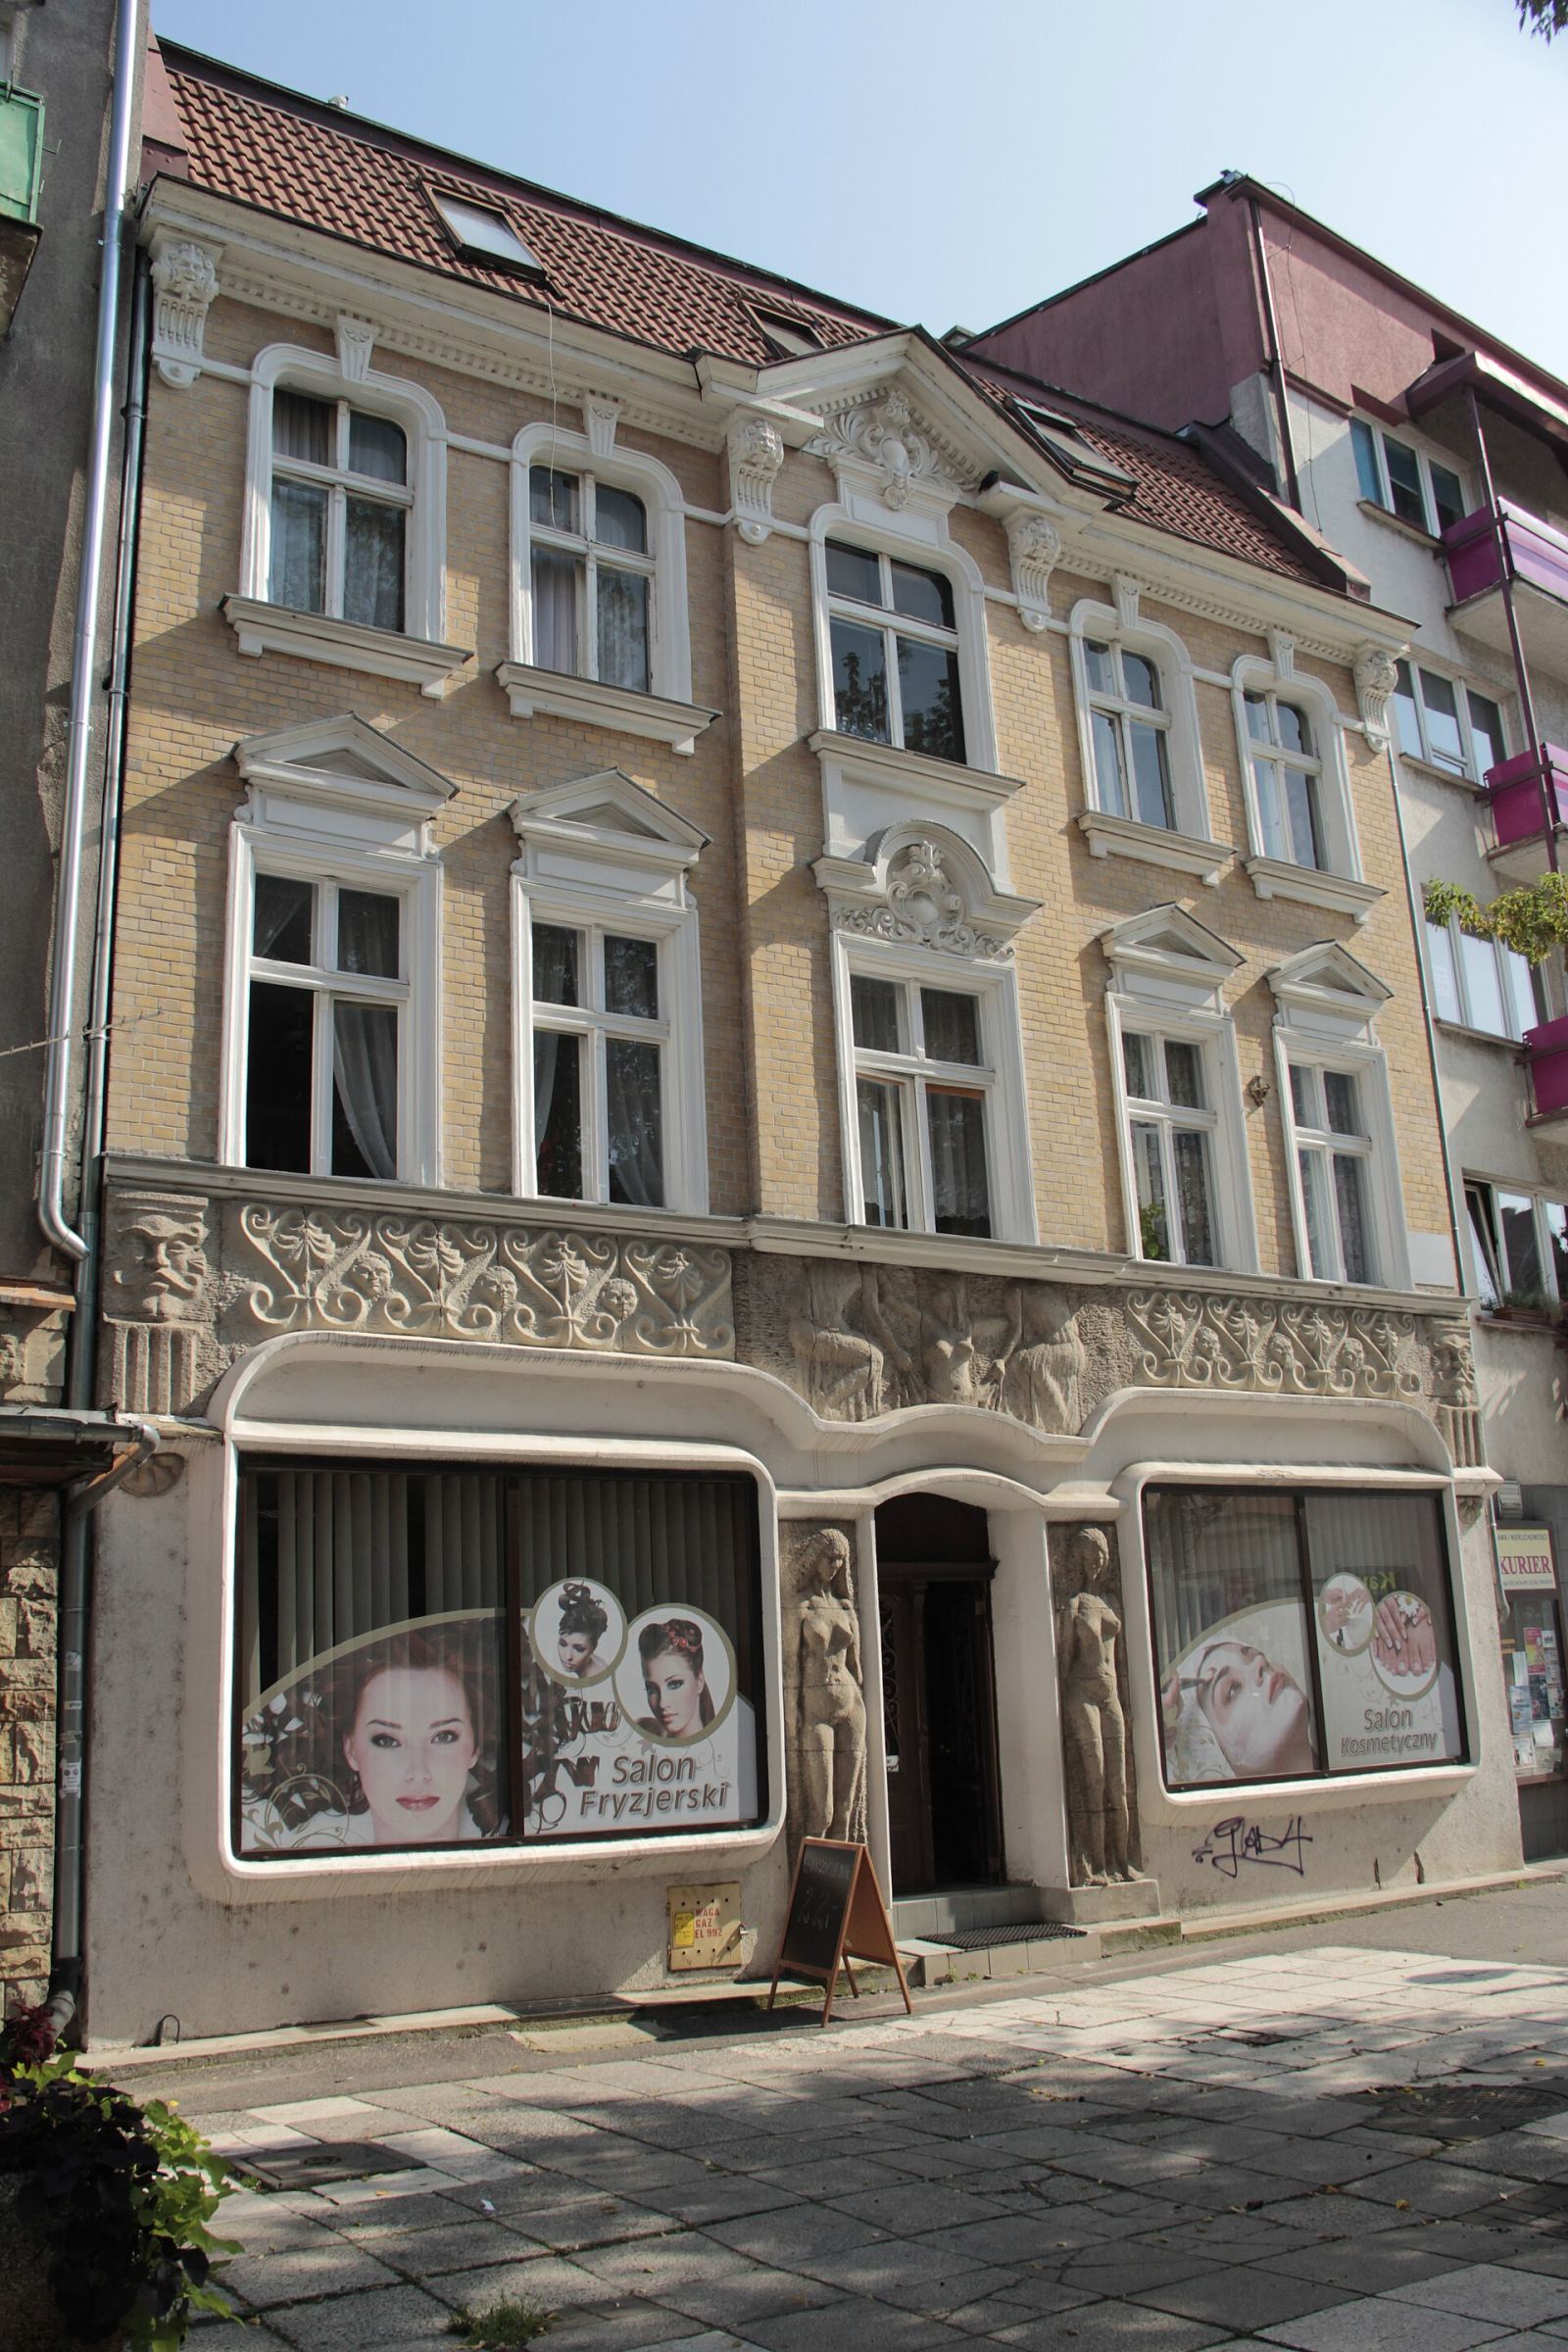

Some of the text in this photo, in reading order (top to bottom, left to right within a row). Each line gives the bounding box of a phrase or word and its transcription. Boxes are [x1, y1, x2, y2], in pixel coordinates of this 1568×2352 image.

[1500, 1555, 1551, 1575] KURIER
[1363, 1708, 1413, 1732] Salon
[1340, 1732, 1439, 1757] Kosmetyczny
[612, 1754, 697, 1785] Salon
[579, 1783, 727, 1820] Fryzjerski
[696, 1918, 712, 1928] GAZ
